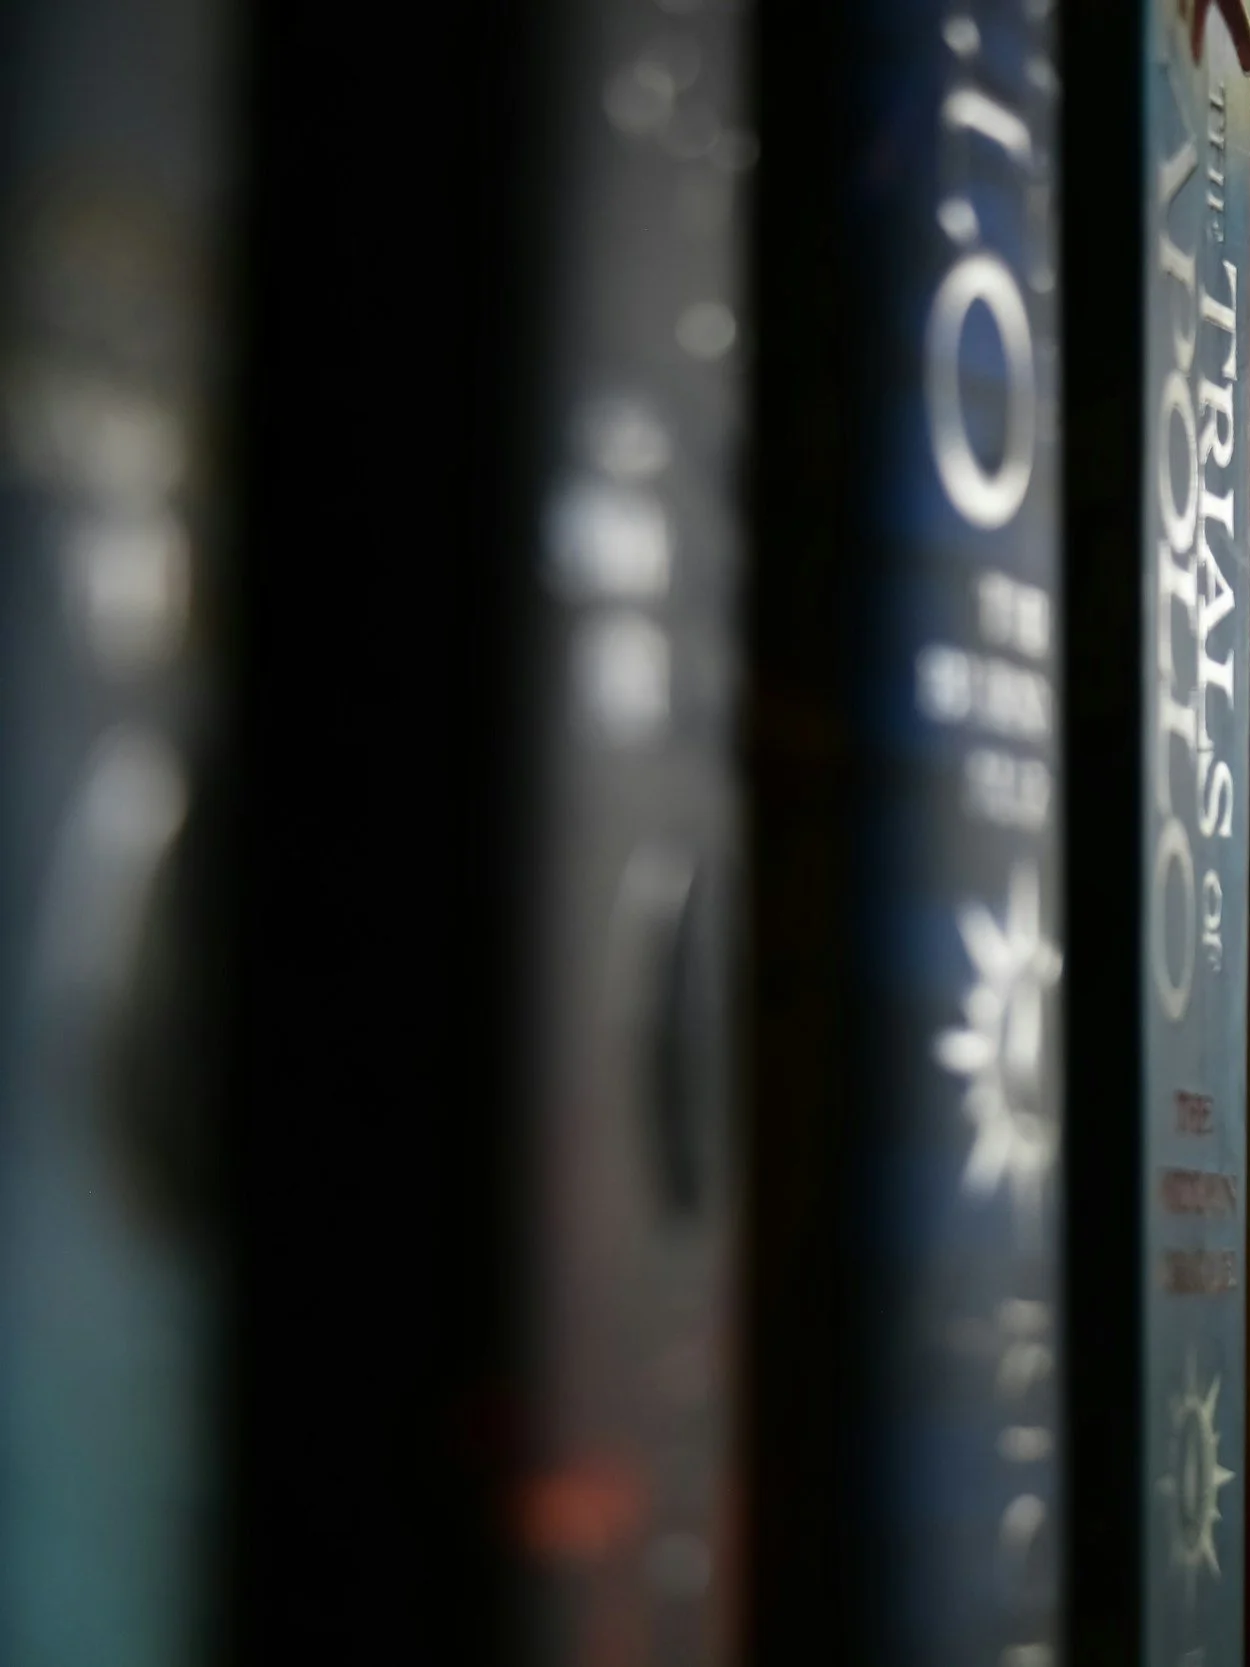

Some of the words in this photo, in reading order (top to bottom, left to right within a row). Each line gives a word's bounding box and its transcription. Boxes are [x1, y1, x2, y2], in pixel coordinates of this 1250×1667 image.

[1152, 60, 1199, 1023] APOLLO
[1197, 258, 1238, 839] TRIALS
[1201, 868, 1224, 973] OF
